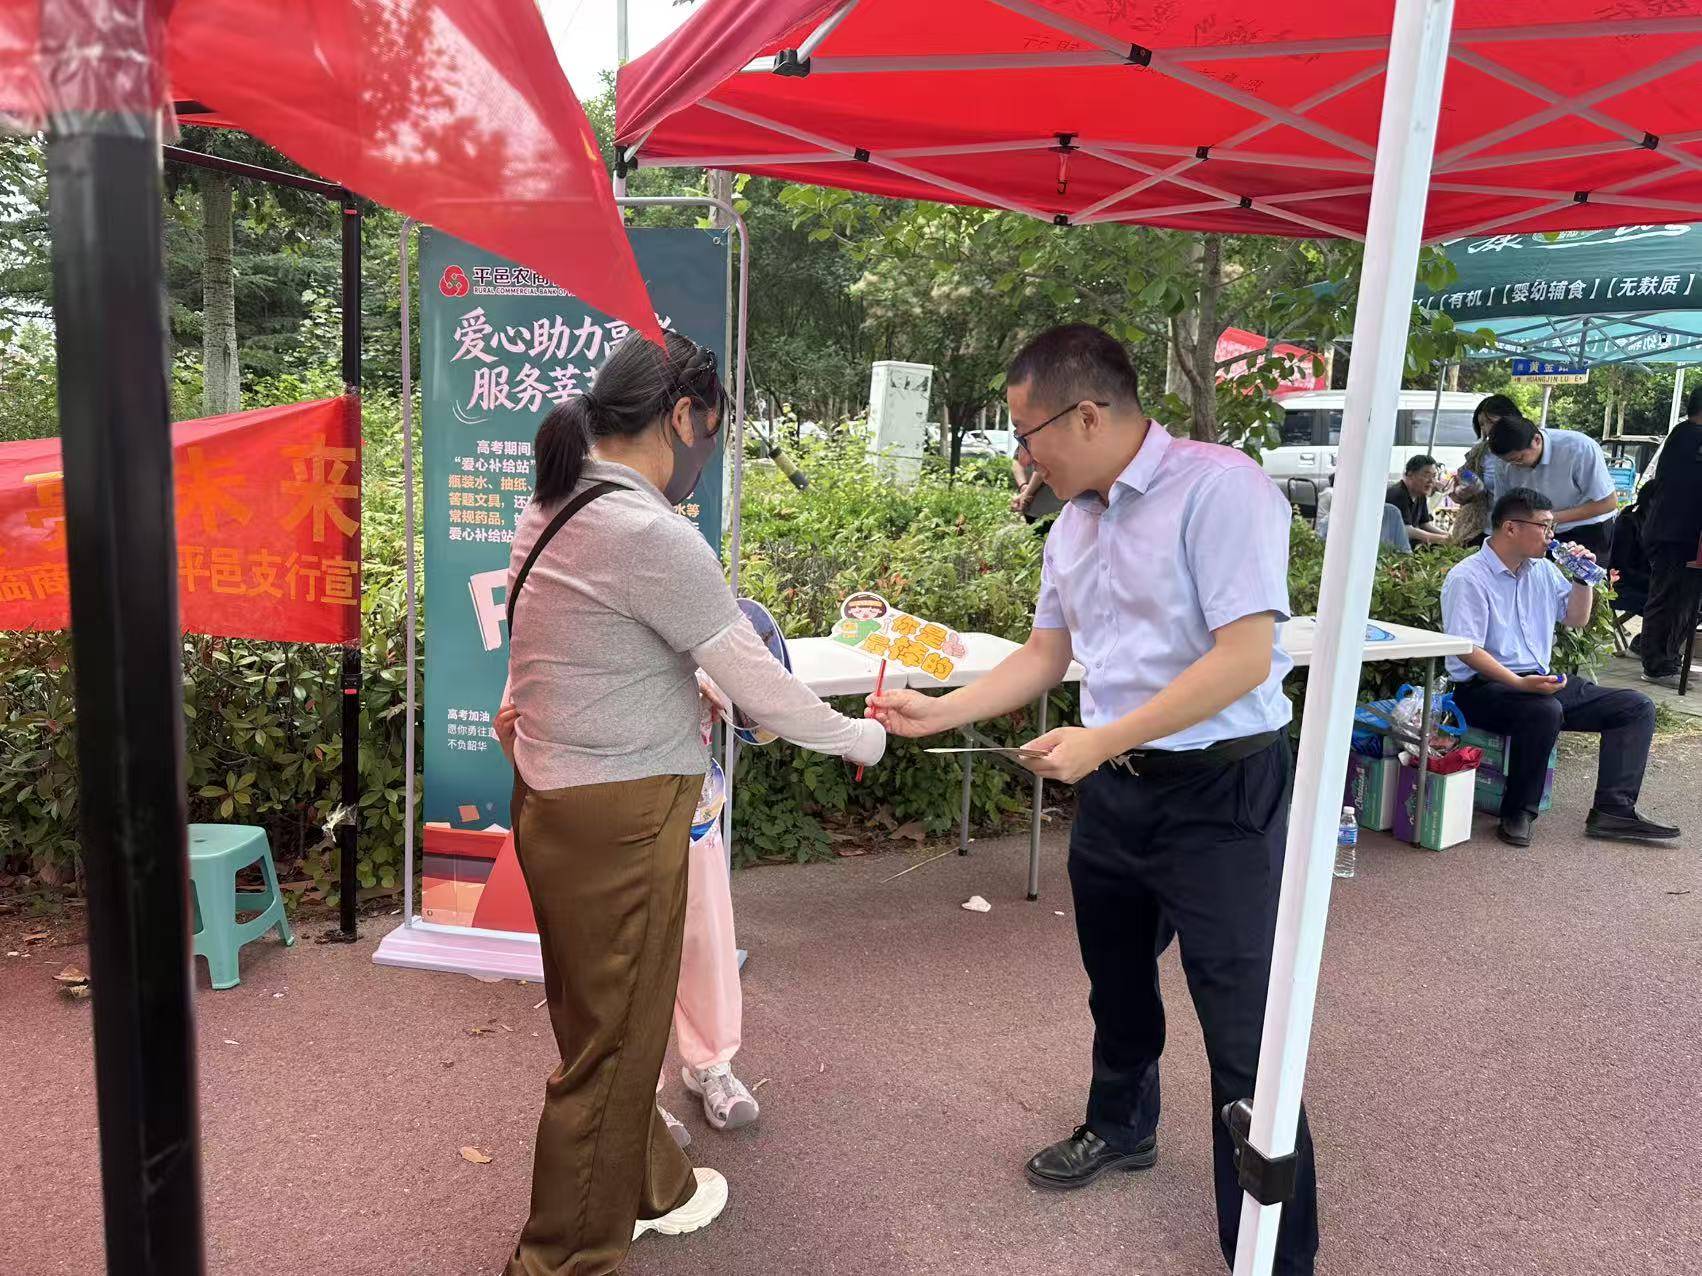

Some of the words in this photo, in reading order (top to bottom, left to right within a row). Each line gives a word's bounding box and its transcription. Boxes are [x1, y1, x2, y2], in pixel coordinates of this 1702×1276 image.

[473, 266, 560, 287] 平邑农商
[473, 286, 494, 295] RURAL
[496, 287, 537, 296] COMMERCIAL
[539, 288, 557, 296] BANK
[451, 306, 676, 362] 爱心助力高
[467, 362, 600, 412] 服务莘
[448, 492, 534, 509] 答题文具，还
[449, 527, 514, 543] 爱心补给站
[447, 708, 490, 722] 高考加油
[447, 738, 488, 751] 不负韶华
